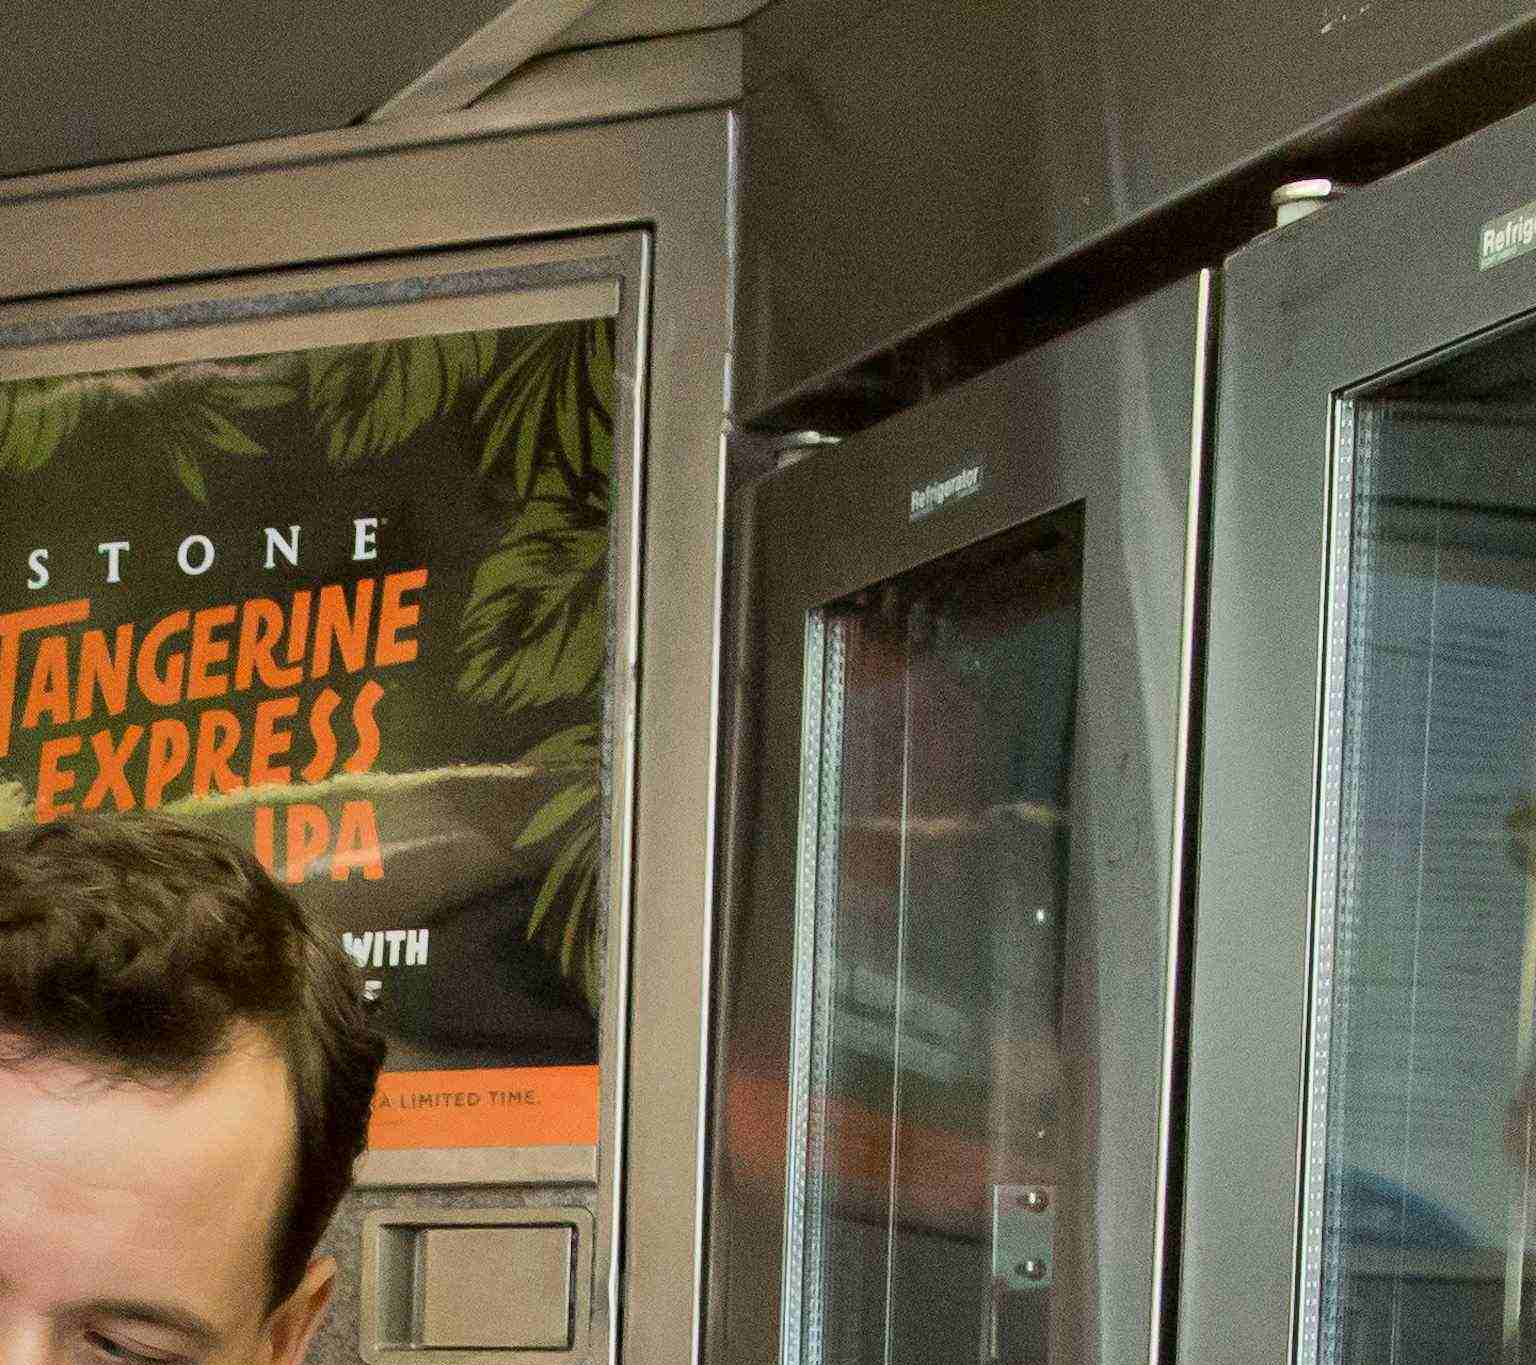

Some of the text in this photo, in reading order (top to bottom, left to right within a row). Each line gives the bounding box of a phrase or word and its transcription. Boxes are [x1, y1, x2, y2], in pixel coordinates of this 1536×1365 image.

[911, 466, 980, 514] Refrigerator
[26, 517, 378, 591] STONE
[33, 682, 386, 822] EXPRESS
[254, 803, 386, 883] IPA
[341, 928, 430, 968] WITH
[399, 1091, 481, 1109] LIMITED
